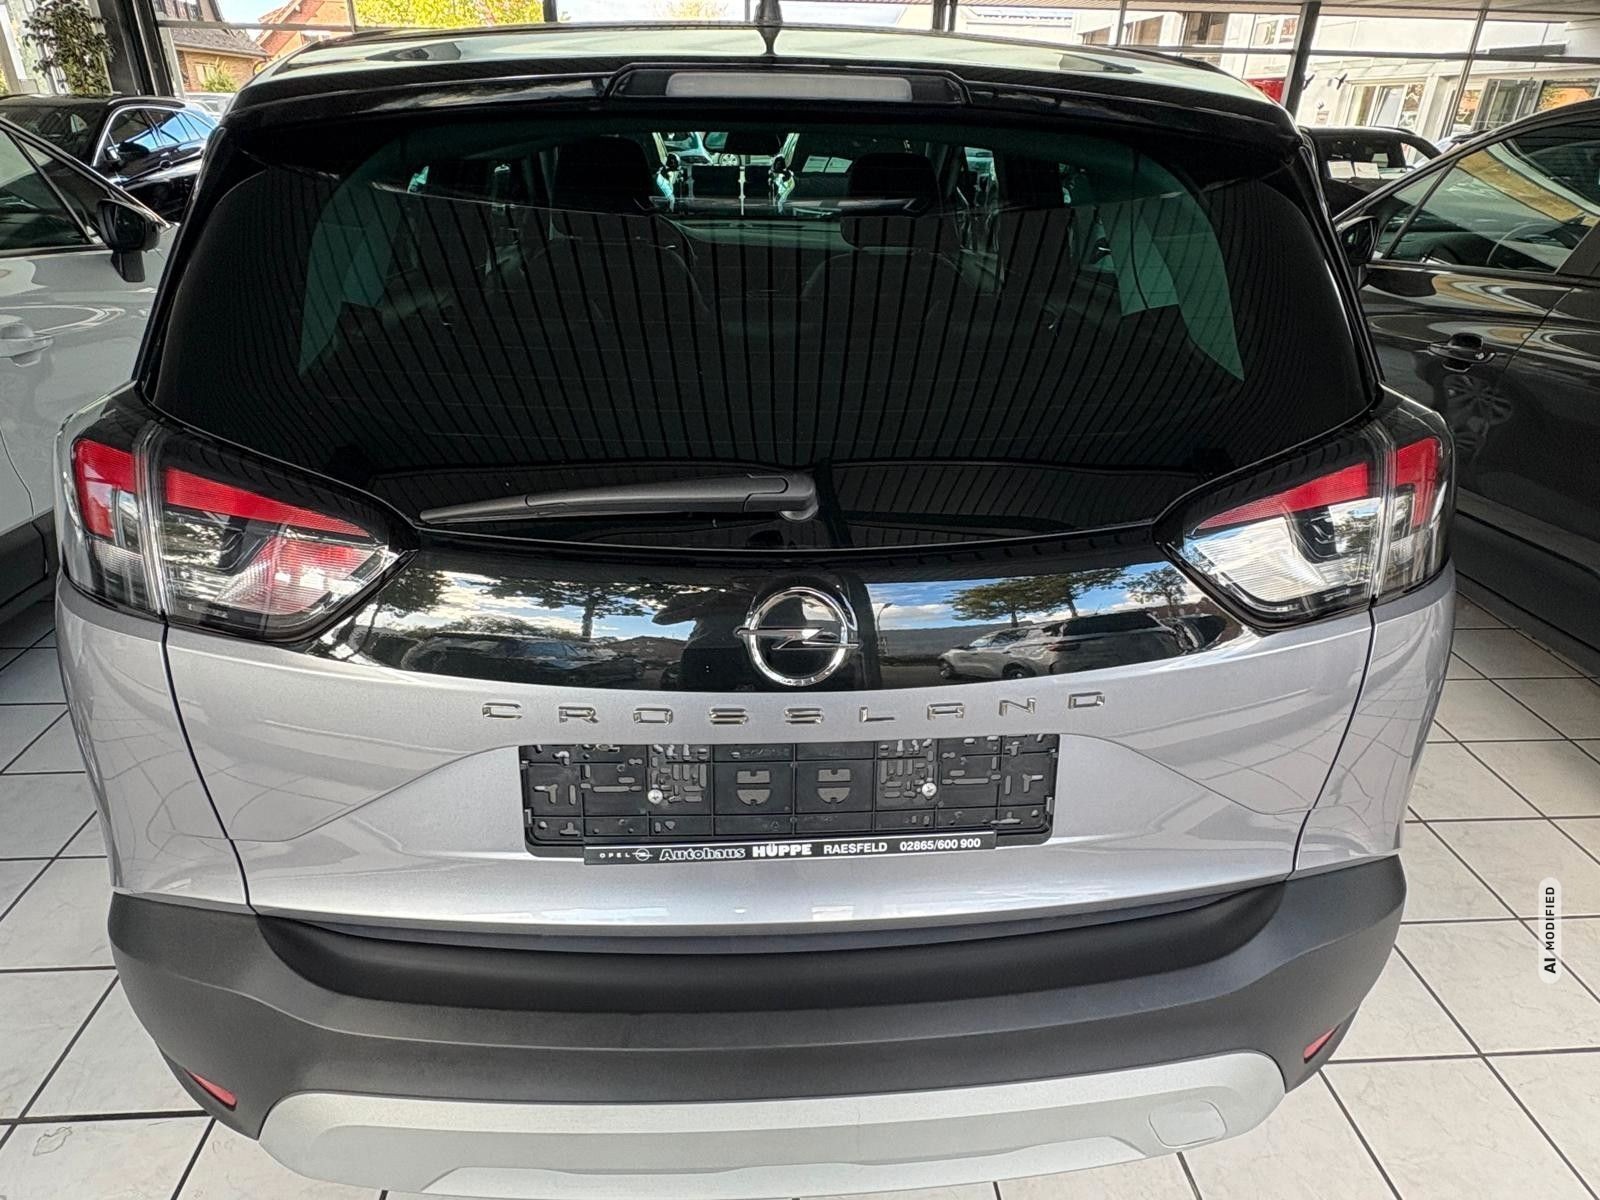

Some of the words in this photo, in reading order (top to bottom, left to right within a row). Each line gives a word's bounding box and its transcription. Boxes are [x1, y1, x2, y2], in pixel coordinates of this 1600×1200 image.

[482, 691, 1105, 725] CROSSLAND
[659, 847, 746, 861] Autohaus
[752, 843, 812, 858] HÜPPE
[823, 842, 888, 855] RAESFELD
[899, 838, 959, 851] 02865/600
[959, 838, 982, 849] 900
